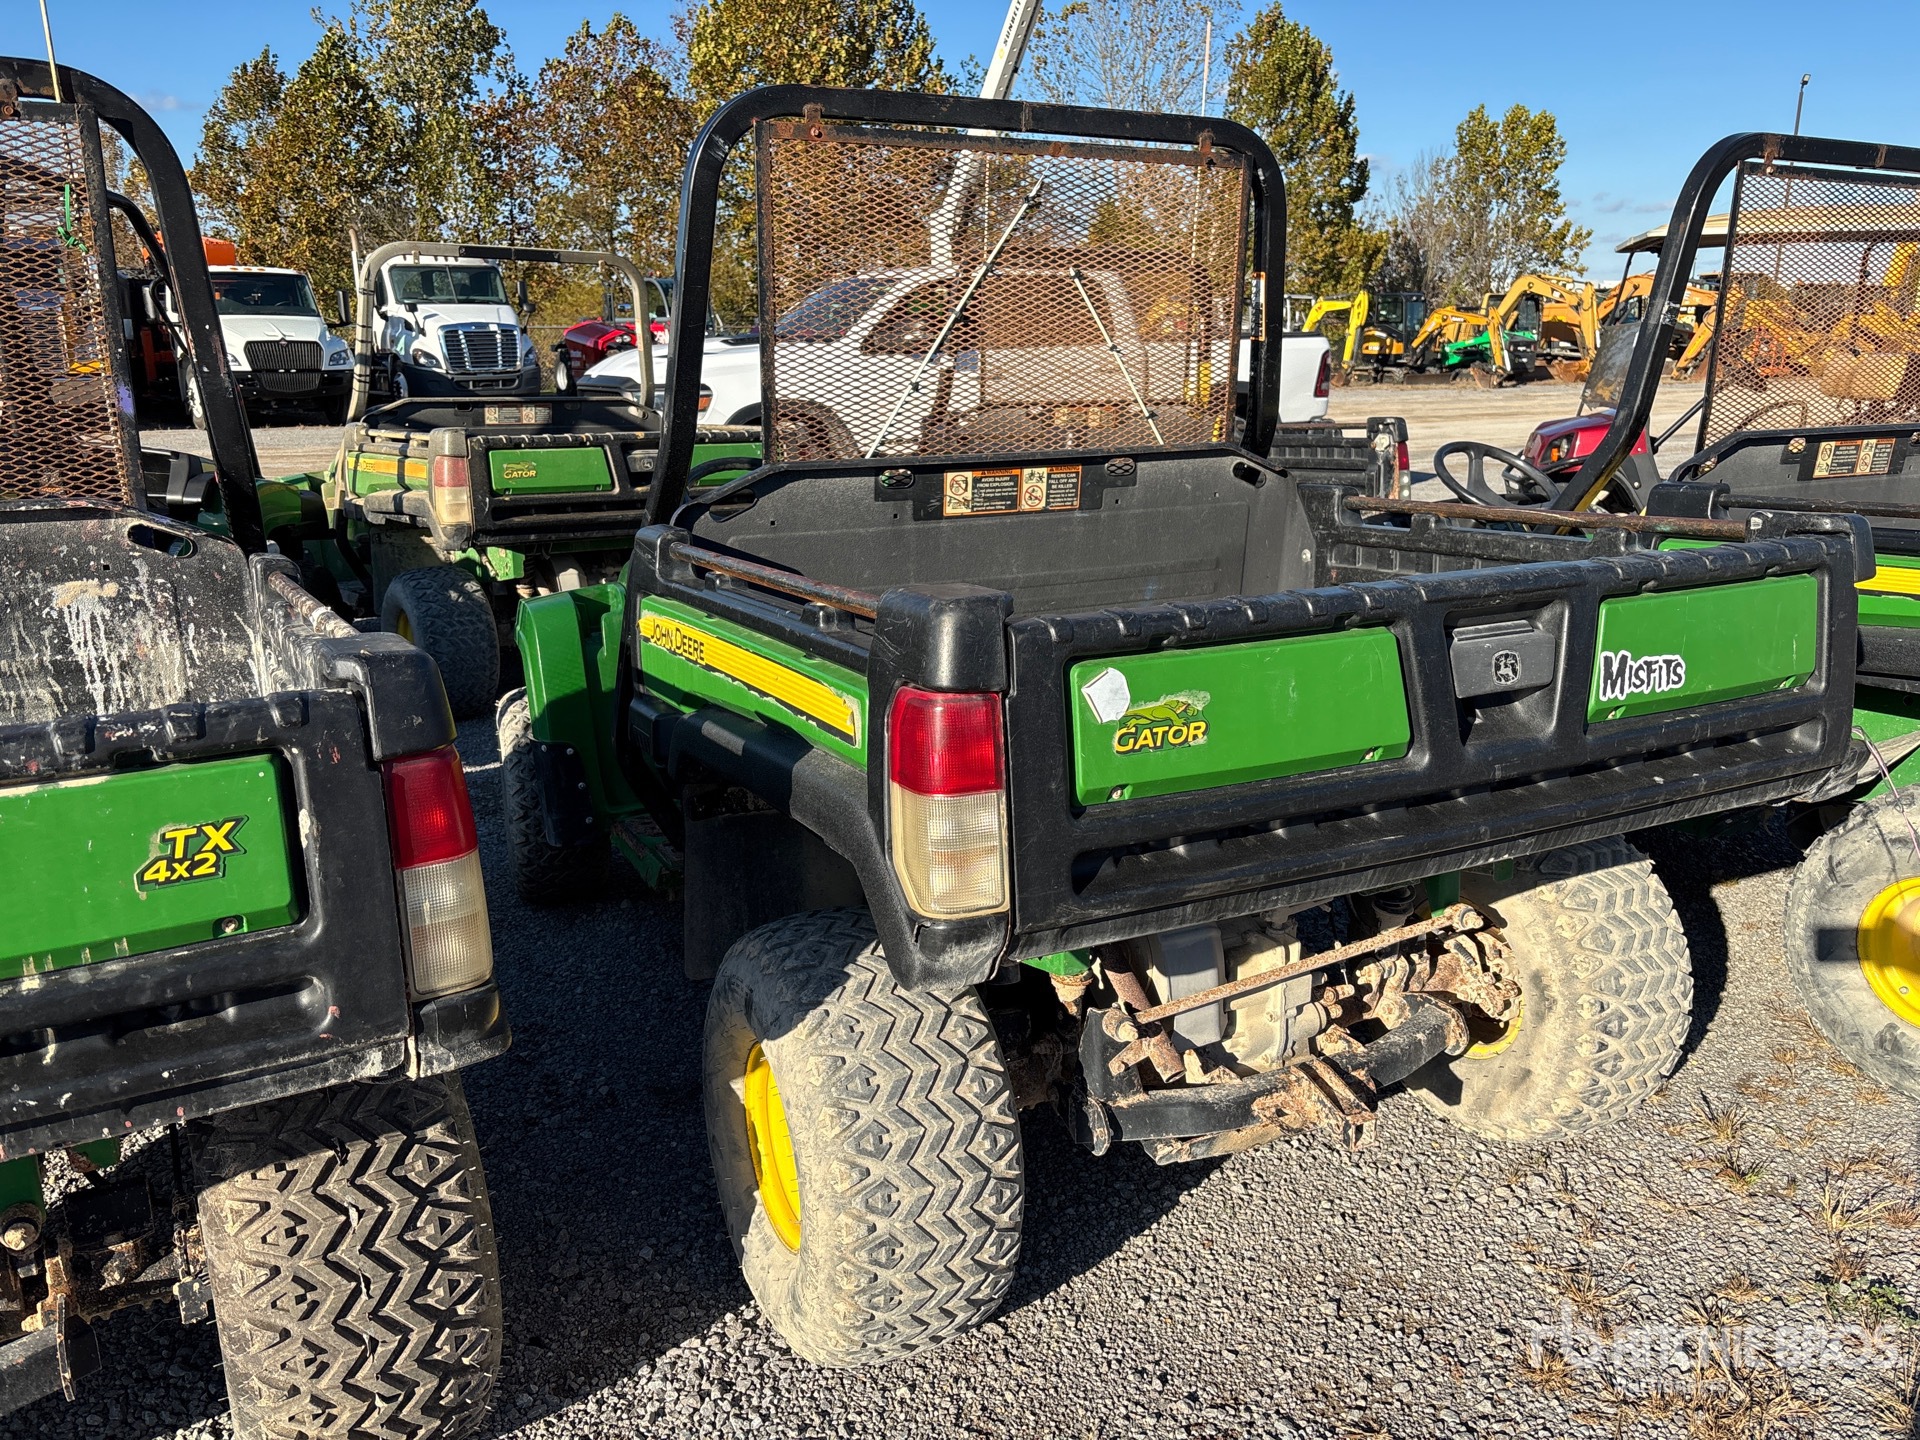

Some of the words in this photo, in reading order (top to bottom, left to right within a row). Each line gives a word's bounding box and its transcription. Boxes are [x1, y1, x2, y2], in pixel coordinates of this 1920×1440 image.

[503, 470, 537, 479] GATOR
[650, 618, 674, 645] JOHN
[675, 627, 706, 660] DEERE
[1115, 720, 1208, 753] GATOR
[164, 820, 237, 860] TX
[143, 851, 217, 883] 4x2
